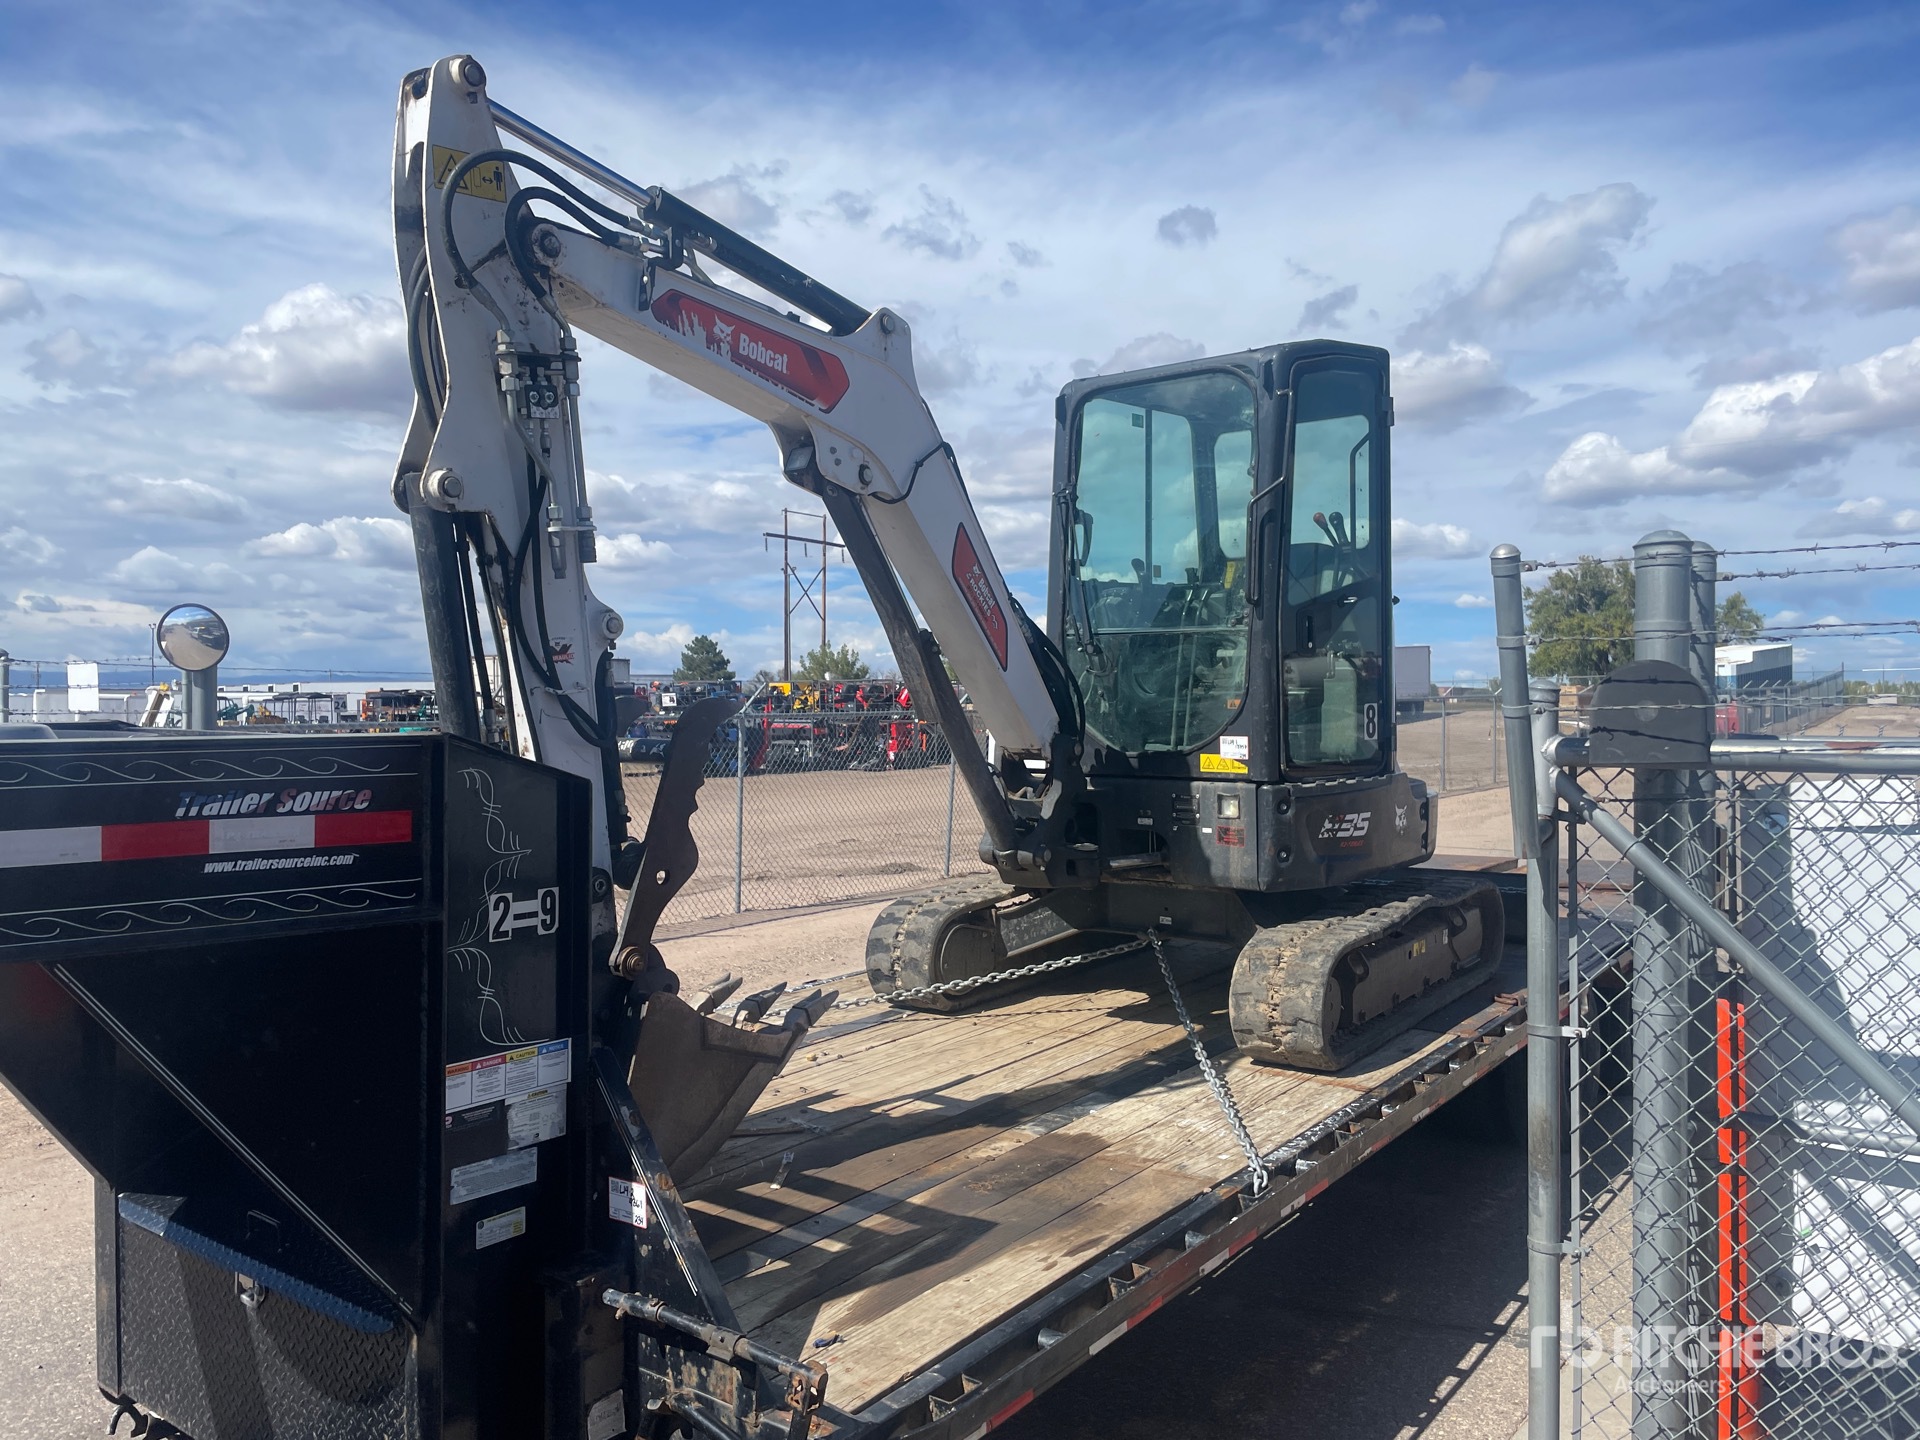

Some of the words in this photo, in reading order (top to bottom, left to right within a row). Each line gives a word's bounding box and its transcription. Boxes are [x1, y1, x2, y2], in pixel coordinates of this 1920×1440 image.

[739, 332, 788, 374] Bobcat
[969, 578, 991, 617] ROCKIES
[978, 578, 996, 609] Bobcat
[334, 701, 347, 710] 24
[1366, 704, 1376, 739] 8
[175, 788, 274, 818] Trailer
[276, 787, 372, 813] Source
[203, 854, 354, 874] www.trailersourceinc.com
[482, 1058, 502, 1068] DANGER
[515, 1049, 536, 1059] CAUTION
